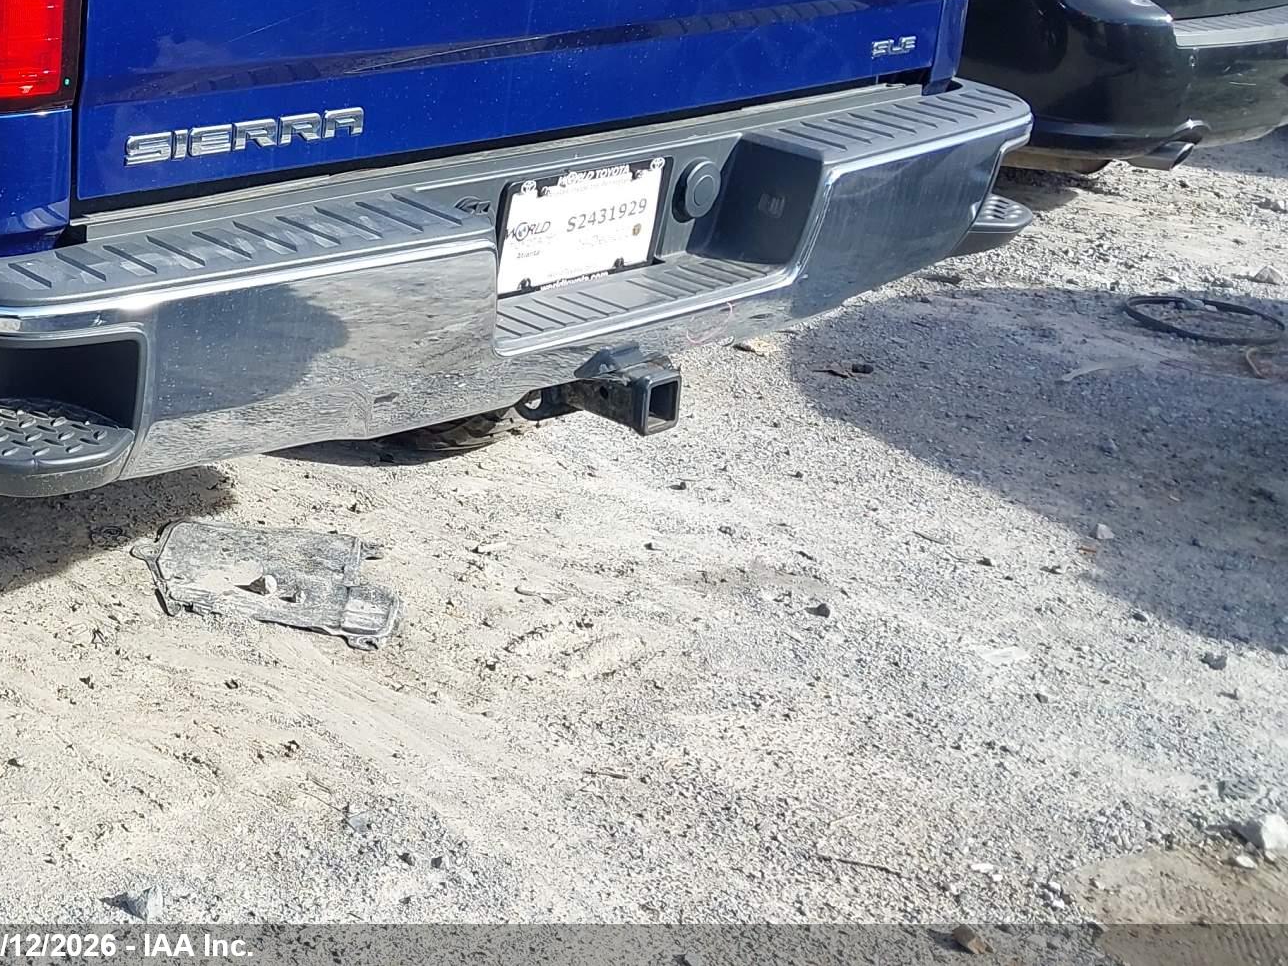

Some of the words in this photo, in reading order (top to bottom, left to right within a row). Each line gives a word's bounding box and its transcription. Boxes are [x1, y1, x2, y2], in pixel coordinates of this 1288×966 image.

[871, 35, 917, 58] SLE
[123, 106, 365, 166] SIERRA
[595, 165, 630, 180] TOYOTA
[565, 197, 648, 233] S2431929
